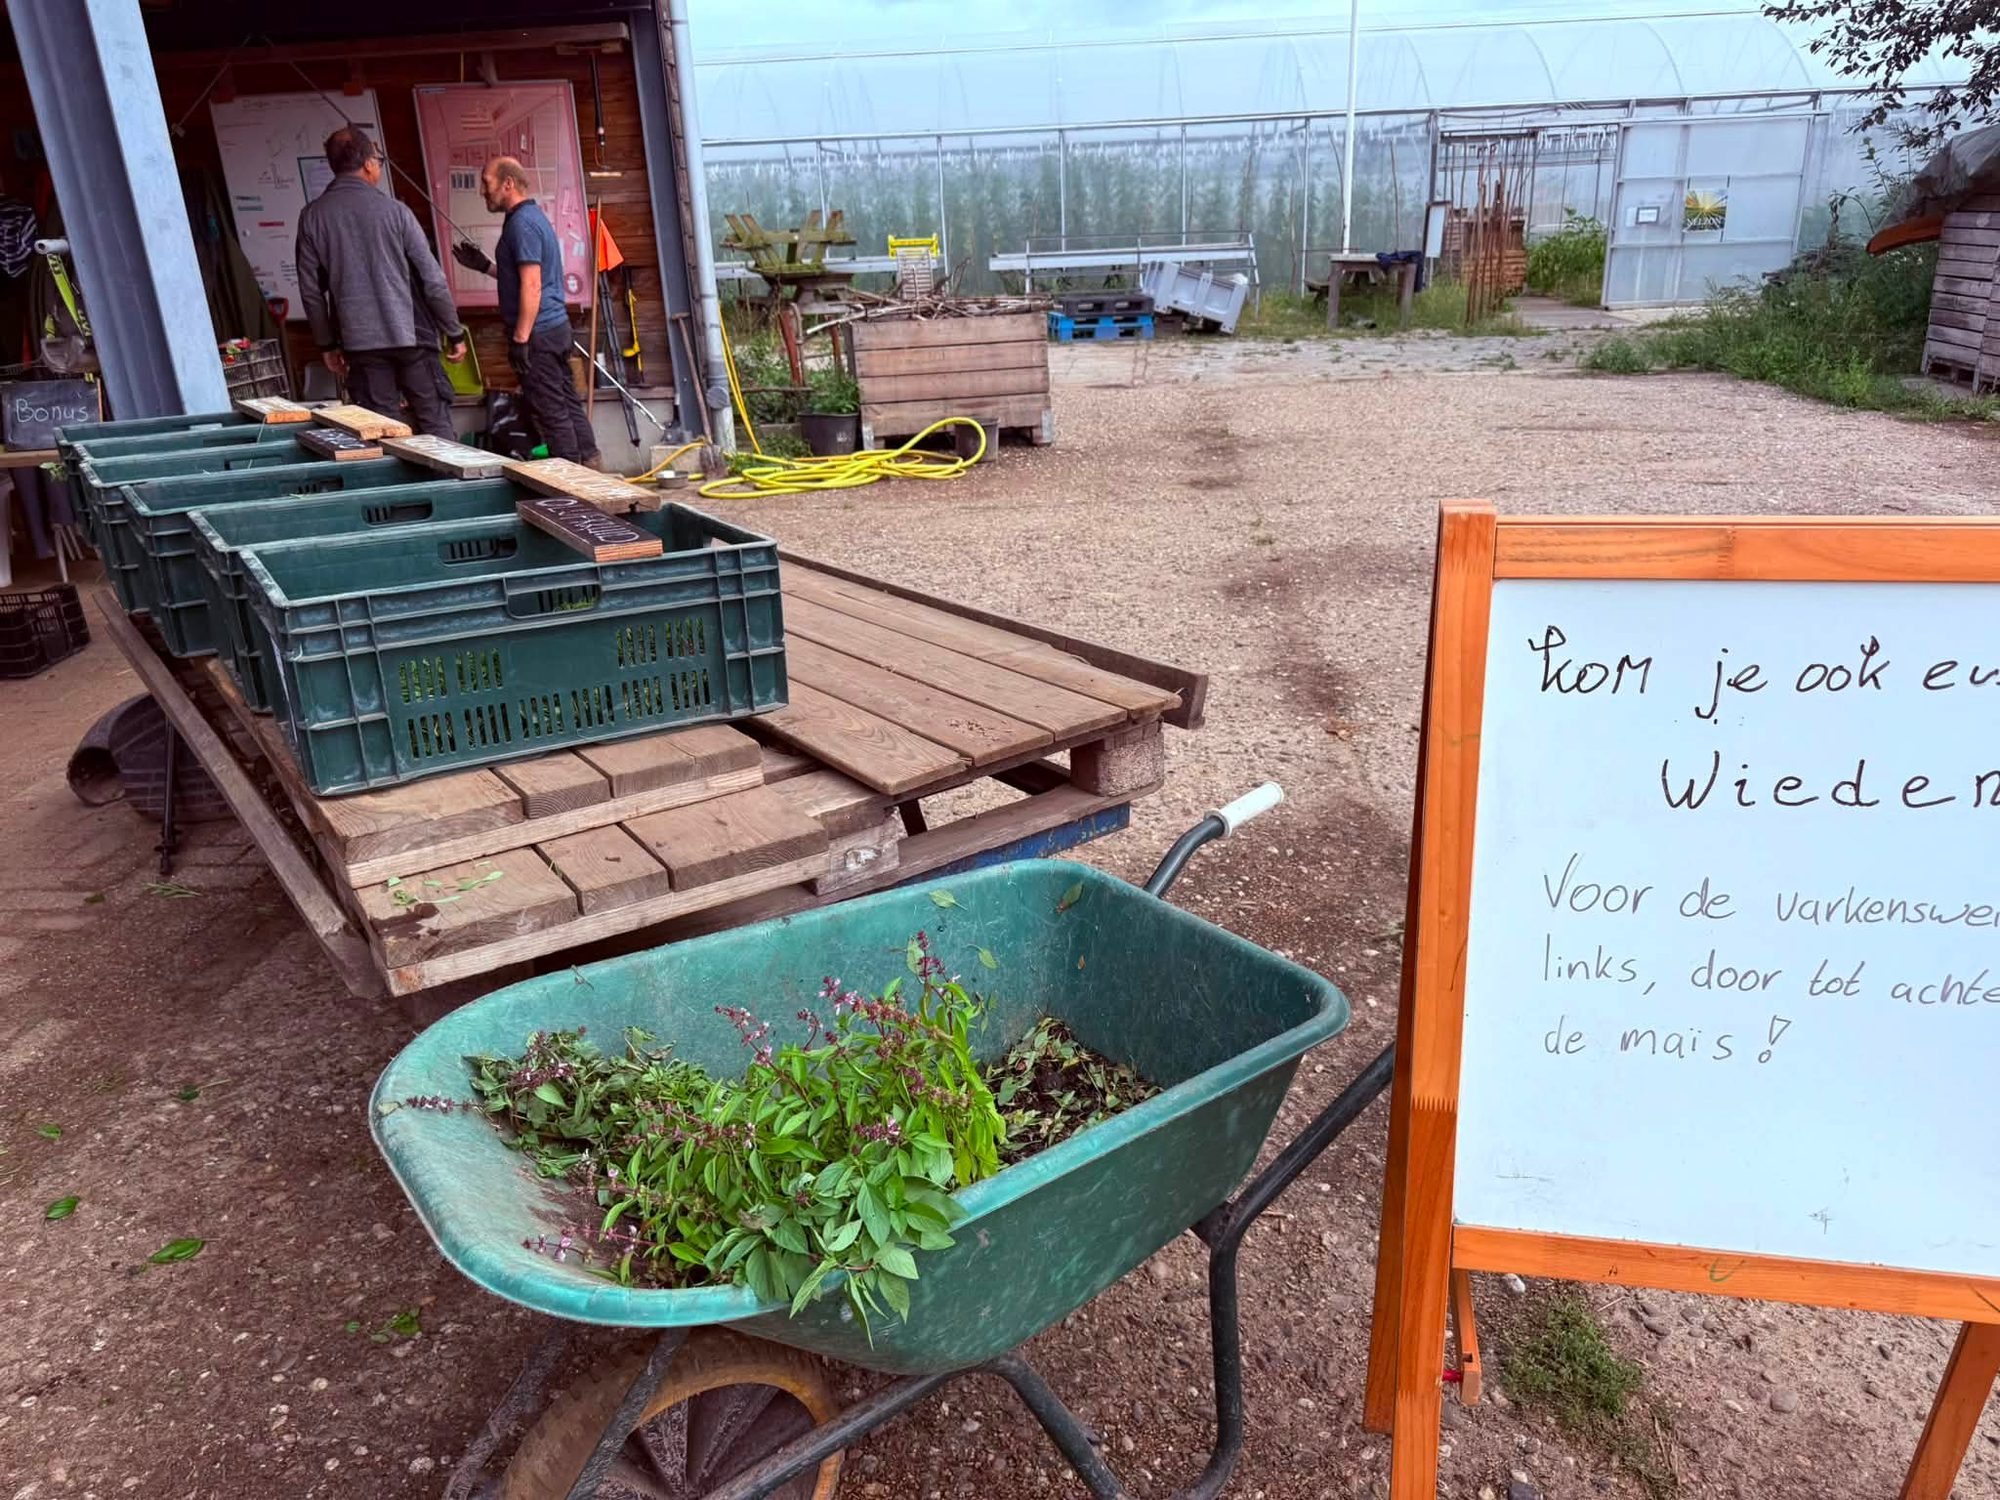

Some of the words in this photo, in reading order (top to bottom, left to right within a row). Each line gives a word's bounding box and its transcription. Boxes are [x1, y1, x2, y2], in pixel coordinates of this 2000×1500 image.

[16, 398, 88, 422] Bonus
[1694, 647, 1768, 722] je
[1795, 634, 1891, 694] ook
[1543, 852, 1654, 914] Voor
[1679, 876, 1736, 920] de
[1544, 932, 1657, 996] links,
[1690, 948, 1783, 992] door
[1808, 958, 1866, 997] tot
[1544, 1014, 1587, 1055] de
